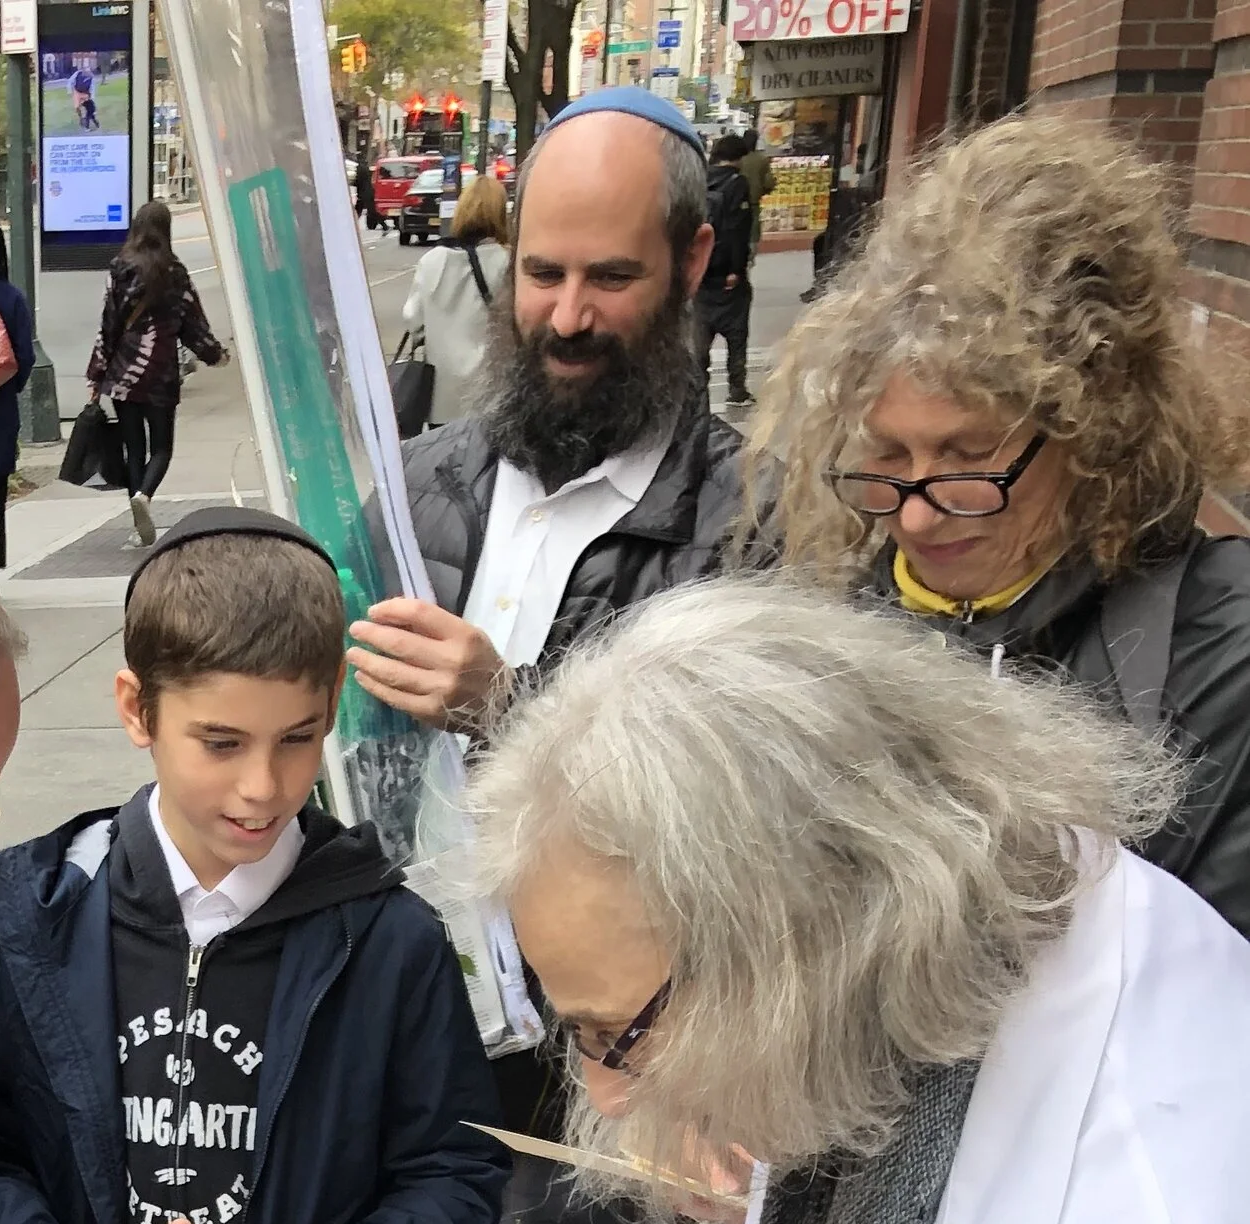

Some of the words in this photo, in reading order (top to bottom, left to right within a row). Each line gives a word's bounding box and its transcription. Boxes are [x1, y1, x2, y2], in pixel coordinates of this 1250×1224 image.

[92, 5, 130, 17] LinkNYC
[733, 0, 812, 41] 20%
[826, 0, 906, 34] OFF
[806, 39, 875, 60] OXFORD
[760, 73, 795, 90] DRY
[798, 68, 875, 88] CLEANERS
